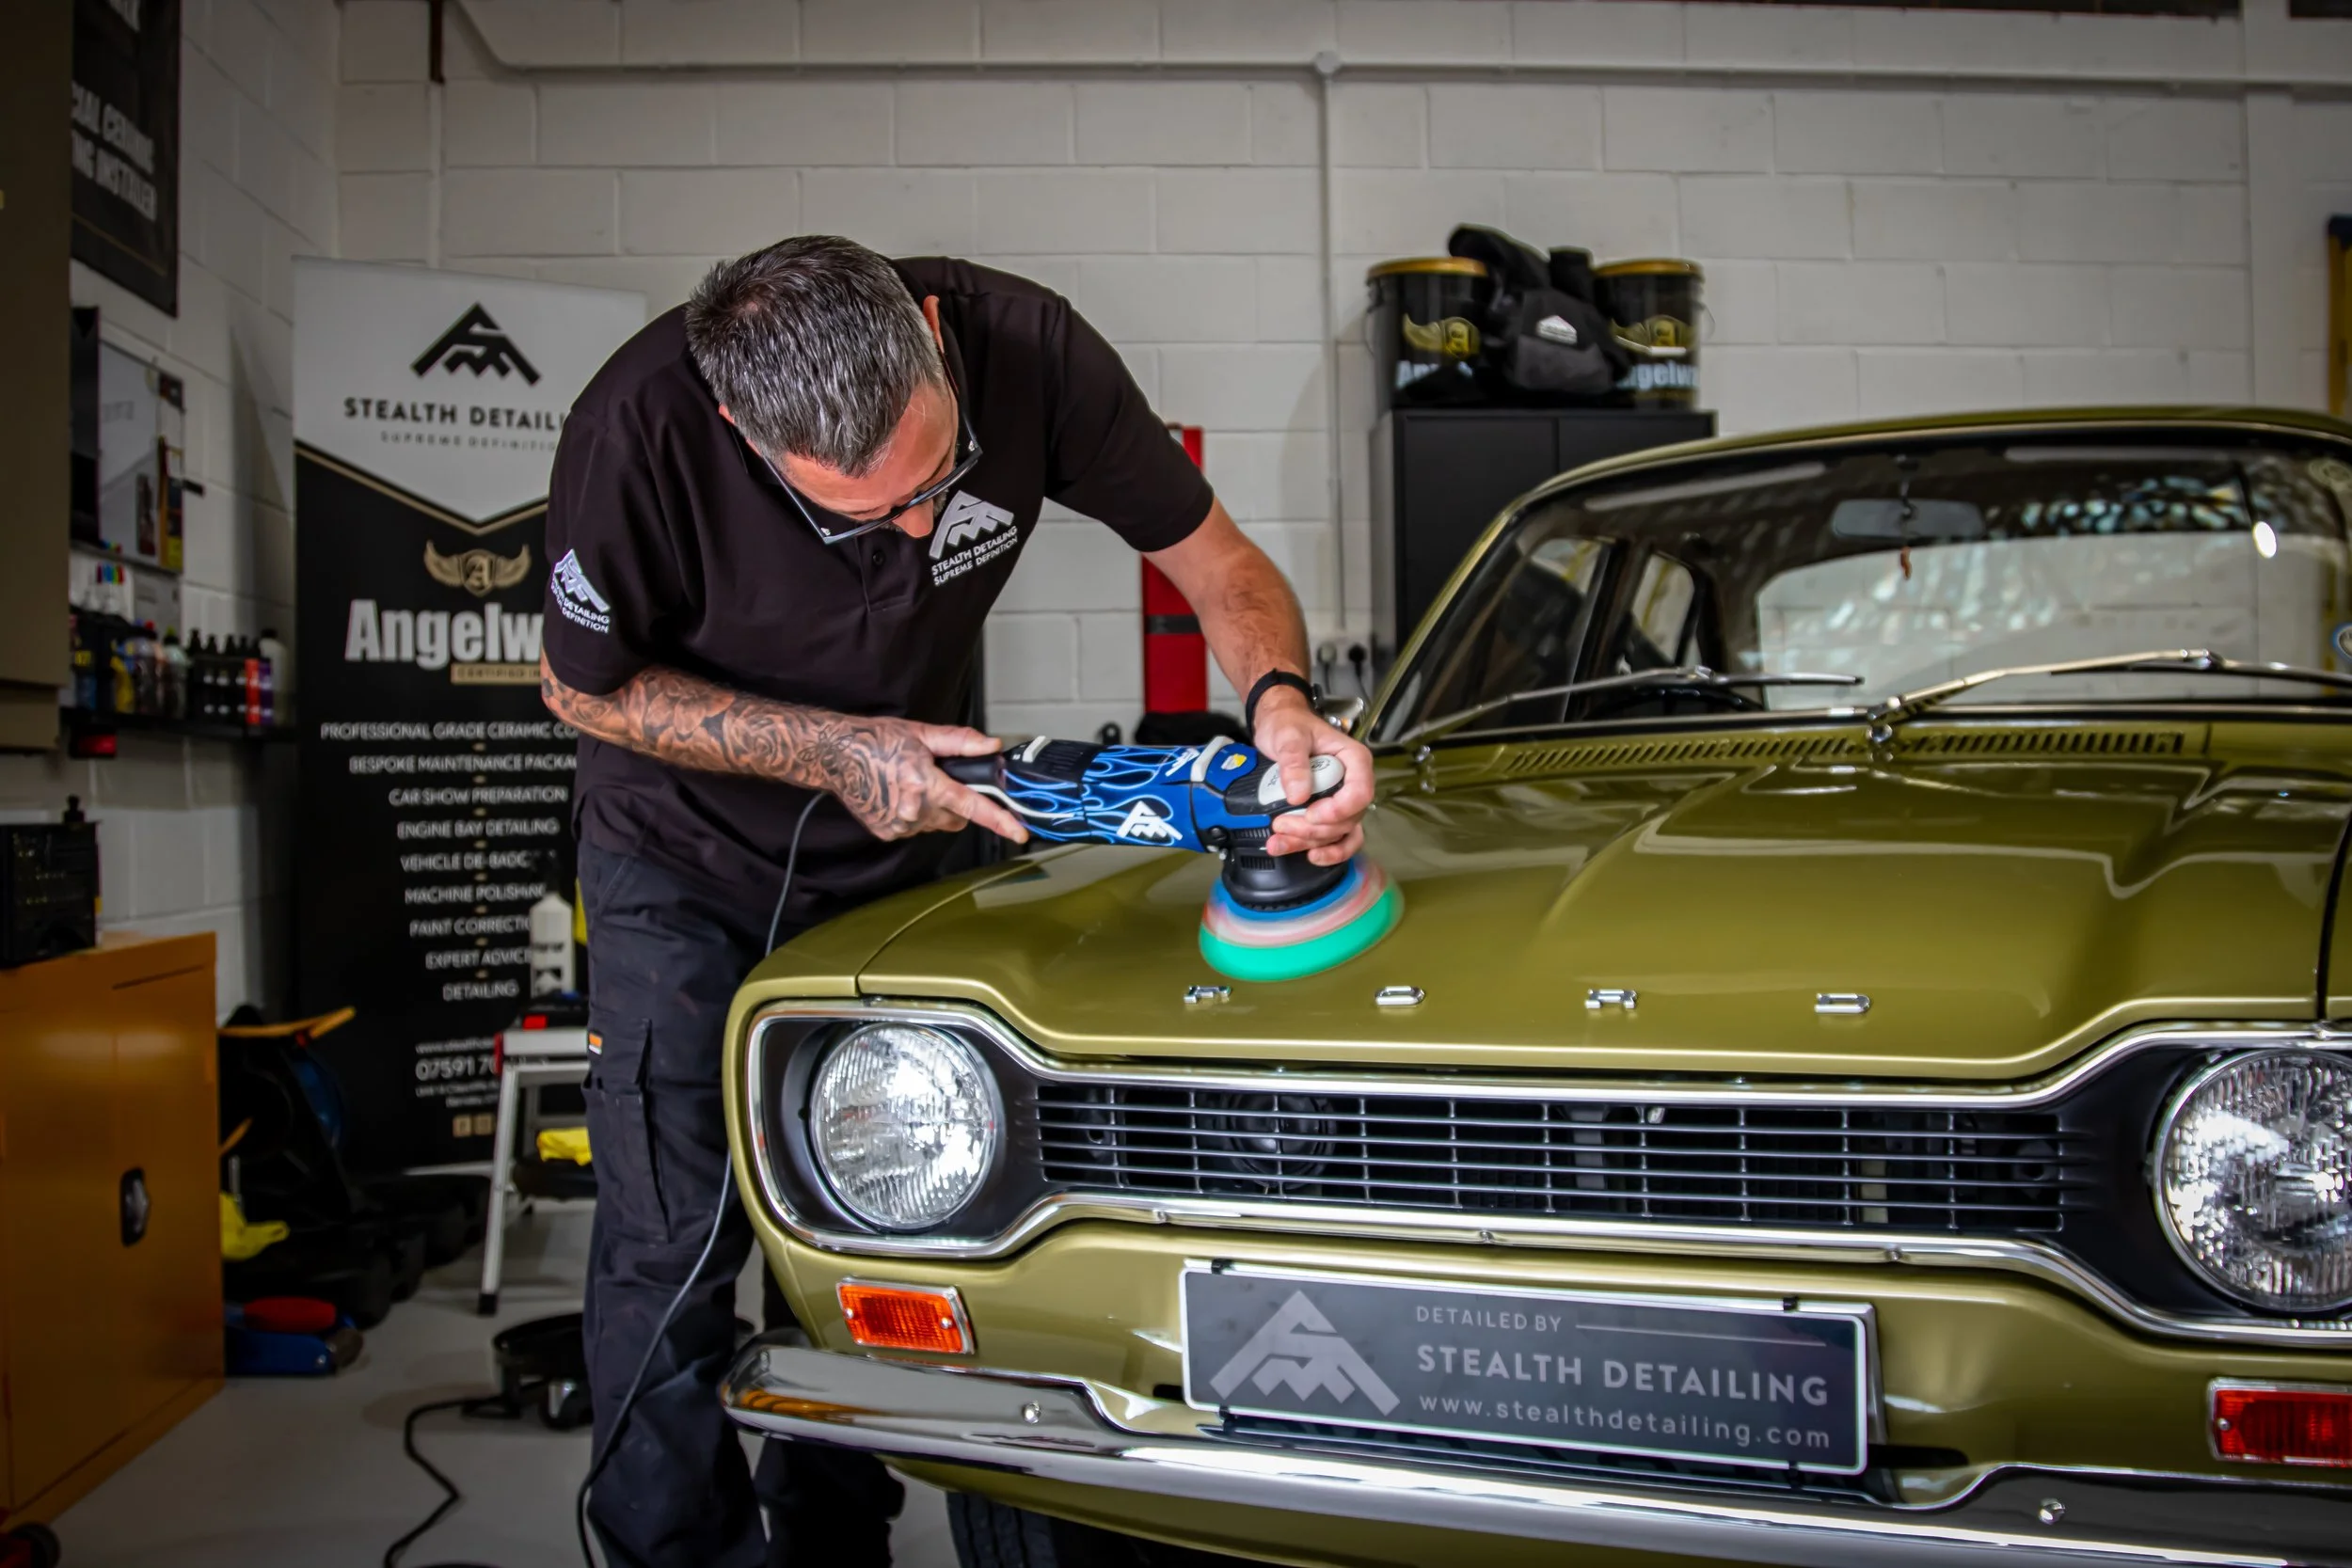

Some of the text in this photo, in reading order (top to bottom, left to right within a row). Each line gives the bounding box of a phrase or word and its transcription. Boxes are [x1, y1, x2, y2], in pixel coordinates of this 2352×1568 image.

[344, 397, 457, 423] STEALTH
[381, 431, 461, 447] SUPREME
[930, 525, 1018, 576] STEALTH DETAILING
[933, 535, 1018, 587] SUPREME DEFINITION
[562, 607, 609, 634] DEFINITION
[564, 596, 610, 625] DETAILING
[321, 721, 431, 740] PROFESSIONAL
[433, 721, 485, 739] GRADE
[487, 721, 552, 739] CERAMIC
[349, 752, 577, 774] BESPOKE MAINTENANCE PACKA
[389, 785, 568, 806] CAR SHOW PREPARATION
[396, 817, 561, 840] ENGINE BAY DETAILING
[400, 853, 459, 872] VEHICLE
[405, 886, 472, 905] MACHINE
[409, 919, 453, 938] PAINT
[425, 951, 479, 970] EXPERT
[442, 979, 519, 1002] DETAILING
[416, 1056, 475, 1081] 07591
[1416, 1306, 1562, 1333] DETAILED BY
[1418, 1345, 1827, 1406] STEALTH DETAILING
[1420, 1395, 1830, 1449] www.stealthdetailing.com
